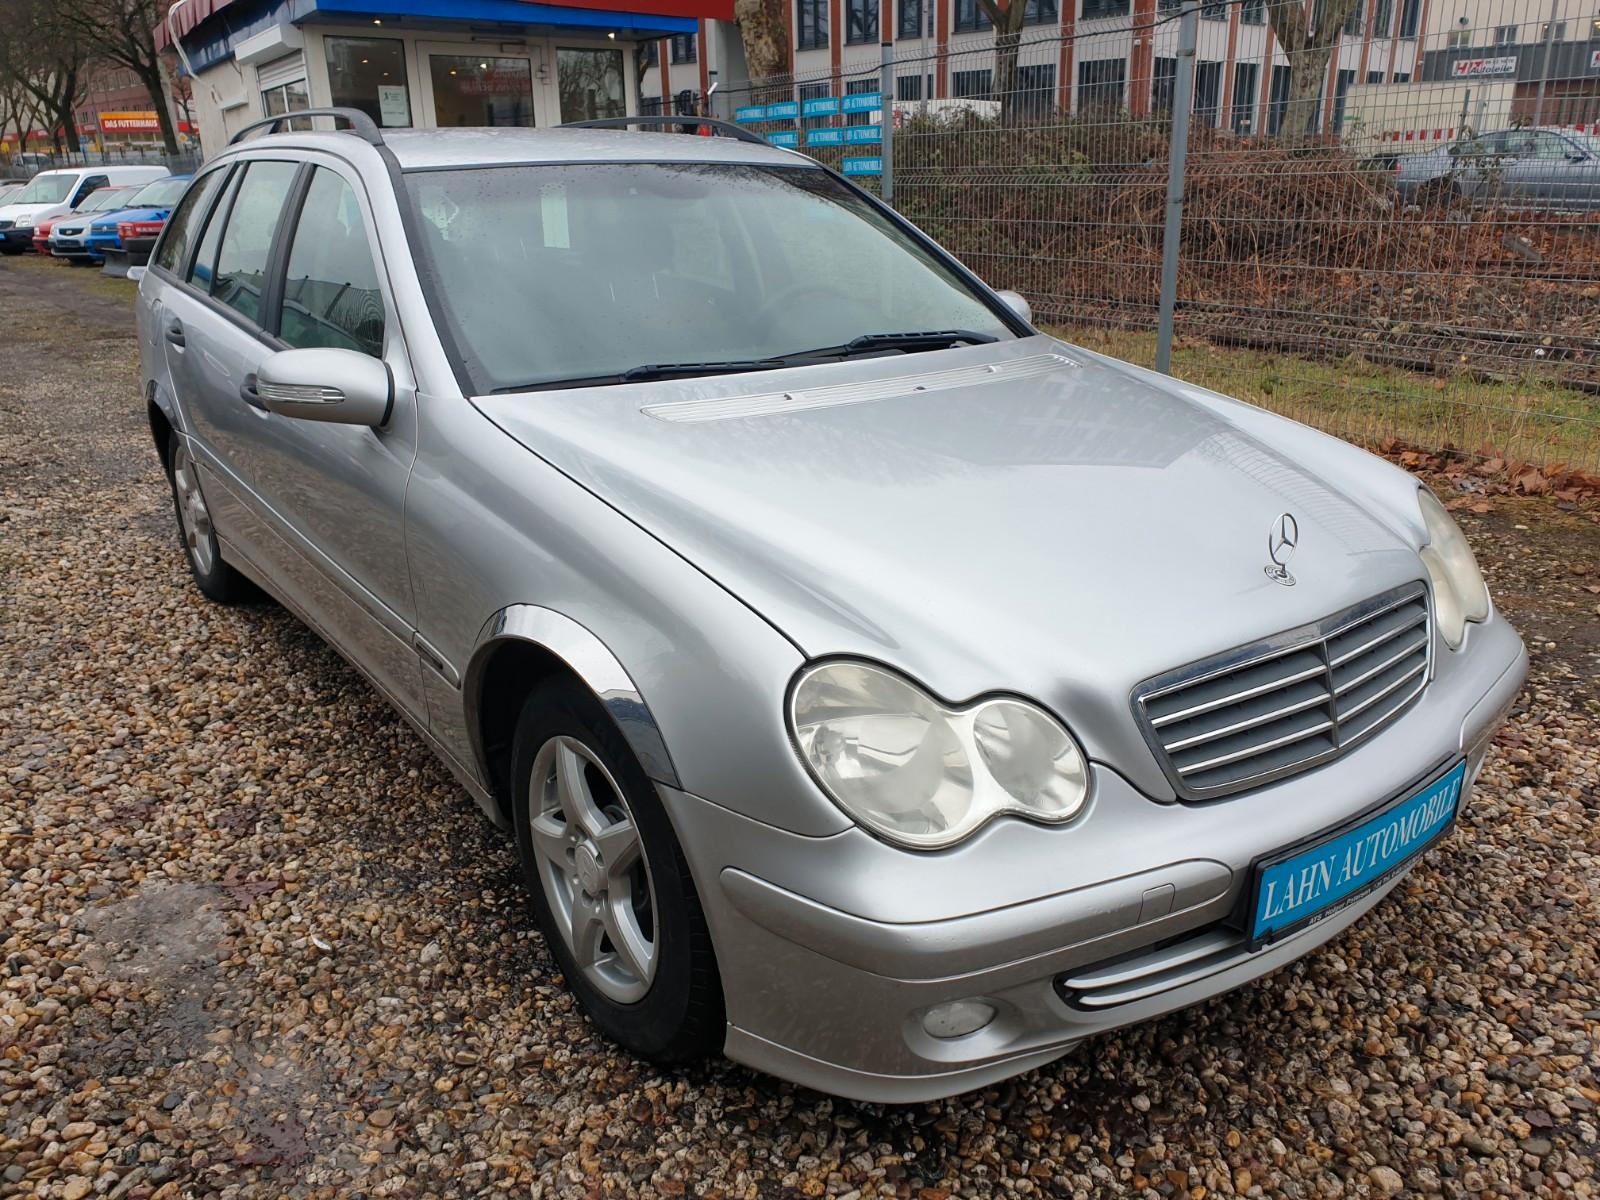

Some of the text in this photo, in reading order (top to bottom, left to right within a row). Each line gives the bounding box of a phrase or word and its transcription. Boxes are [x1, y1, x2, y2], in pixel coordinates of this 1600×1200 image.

[104, 119, 118, 129] DAS
[118, 119, 158, 128] FUTTERHAUS
[1262, 854, 1337, 922] LAHN
[1335, 775, 1461, 887] AUTOMOBILE
